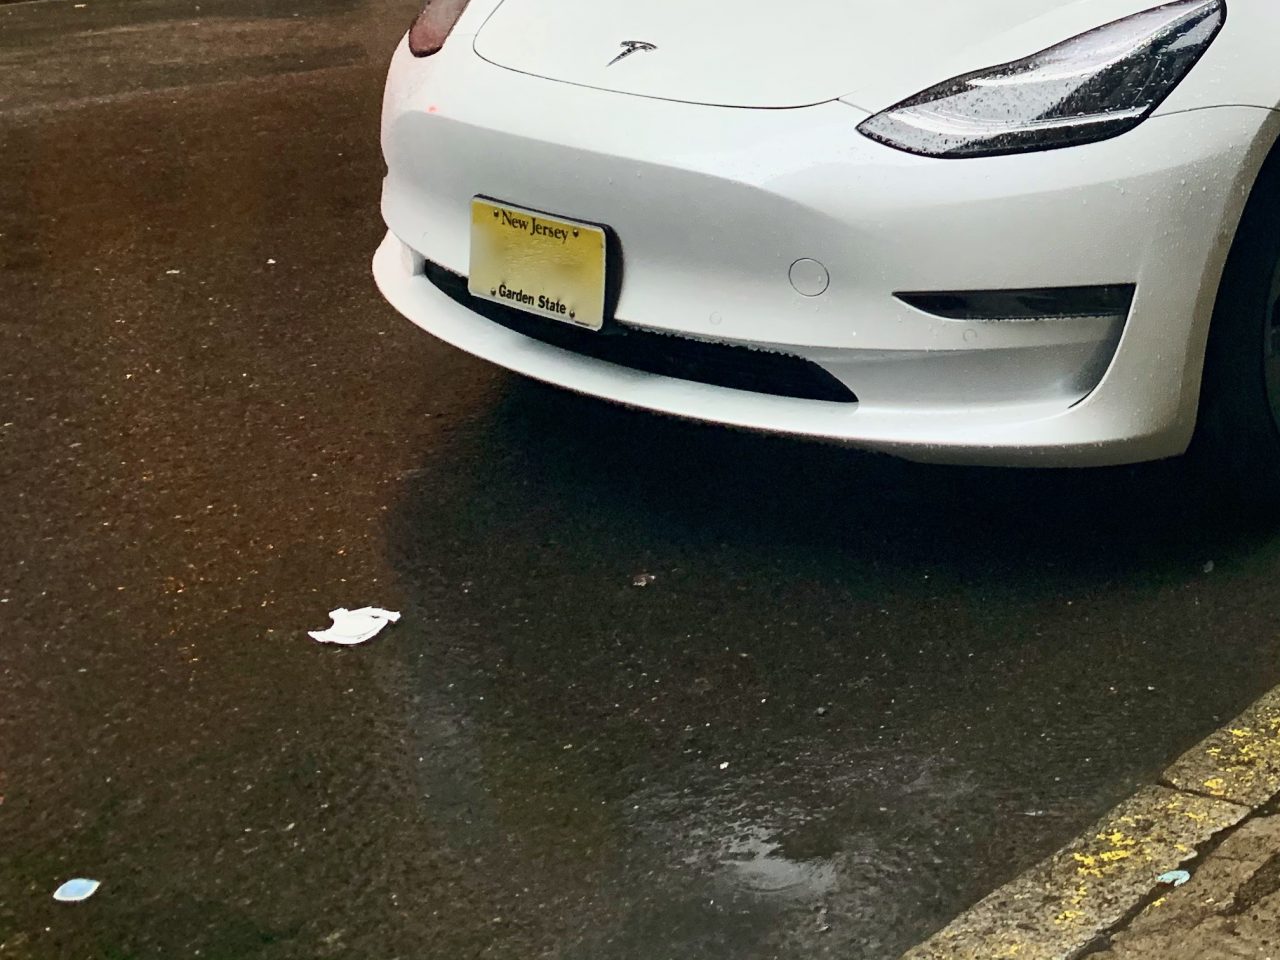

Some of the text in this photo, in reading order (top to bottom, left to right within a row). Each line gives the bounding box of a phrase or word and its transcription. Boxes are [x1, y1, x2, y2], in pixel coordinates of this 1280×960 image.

[500, 208, 569, 244] New Jersey
[498, 284, 567, 315] Garden State
